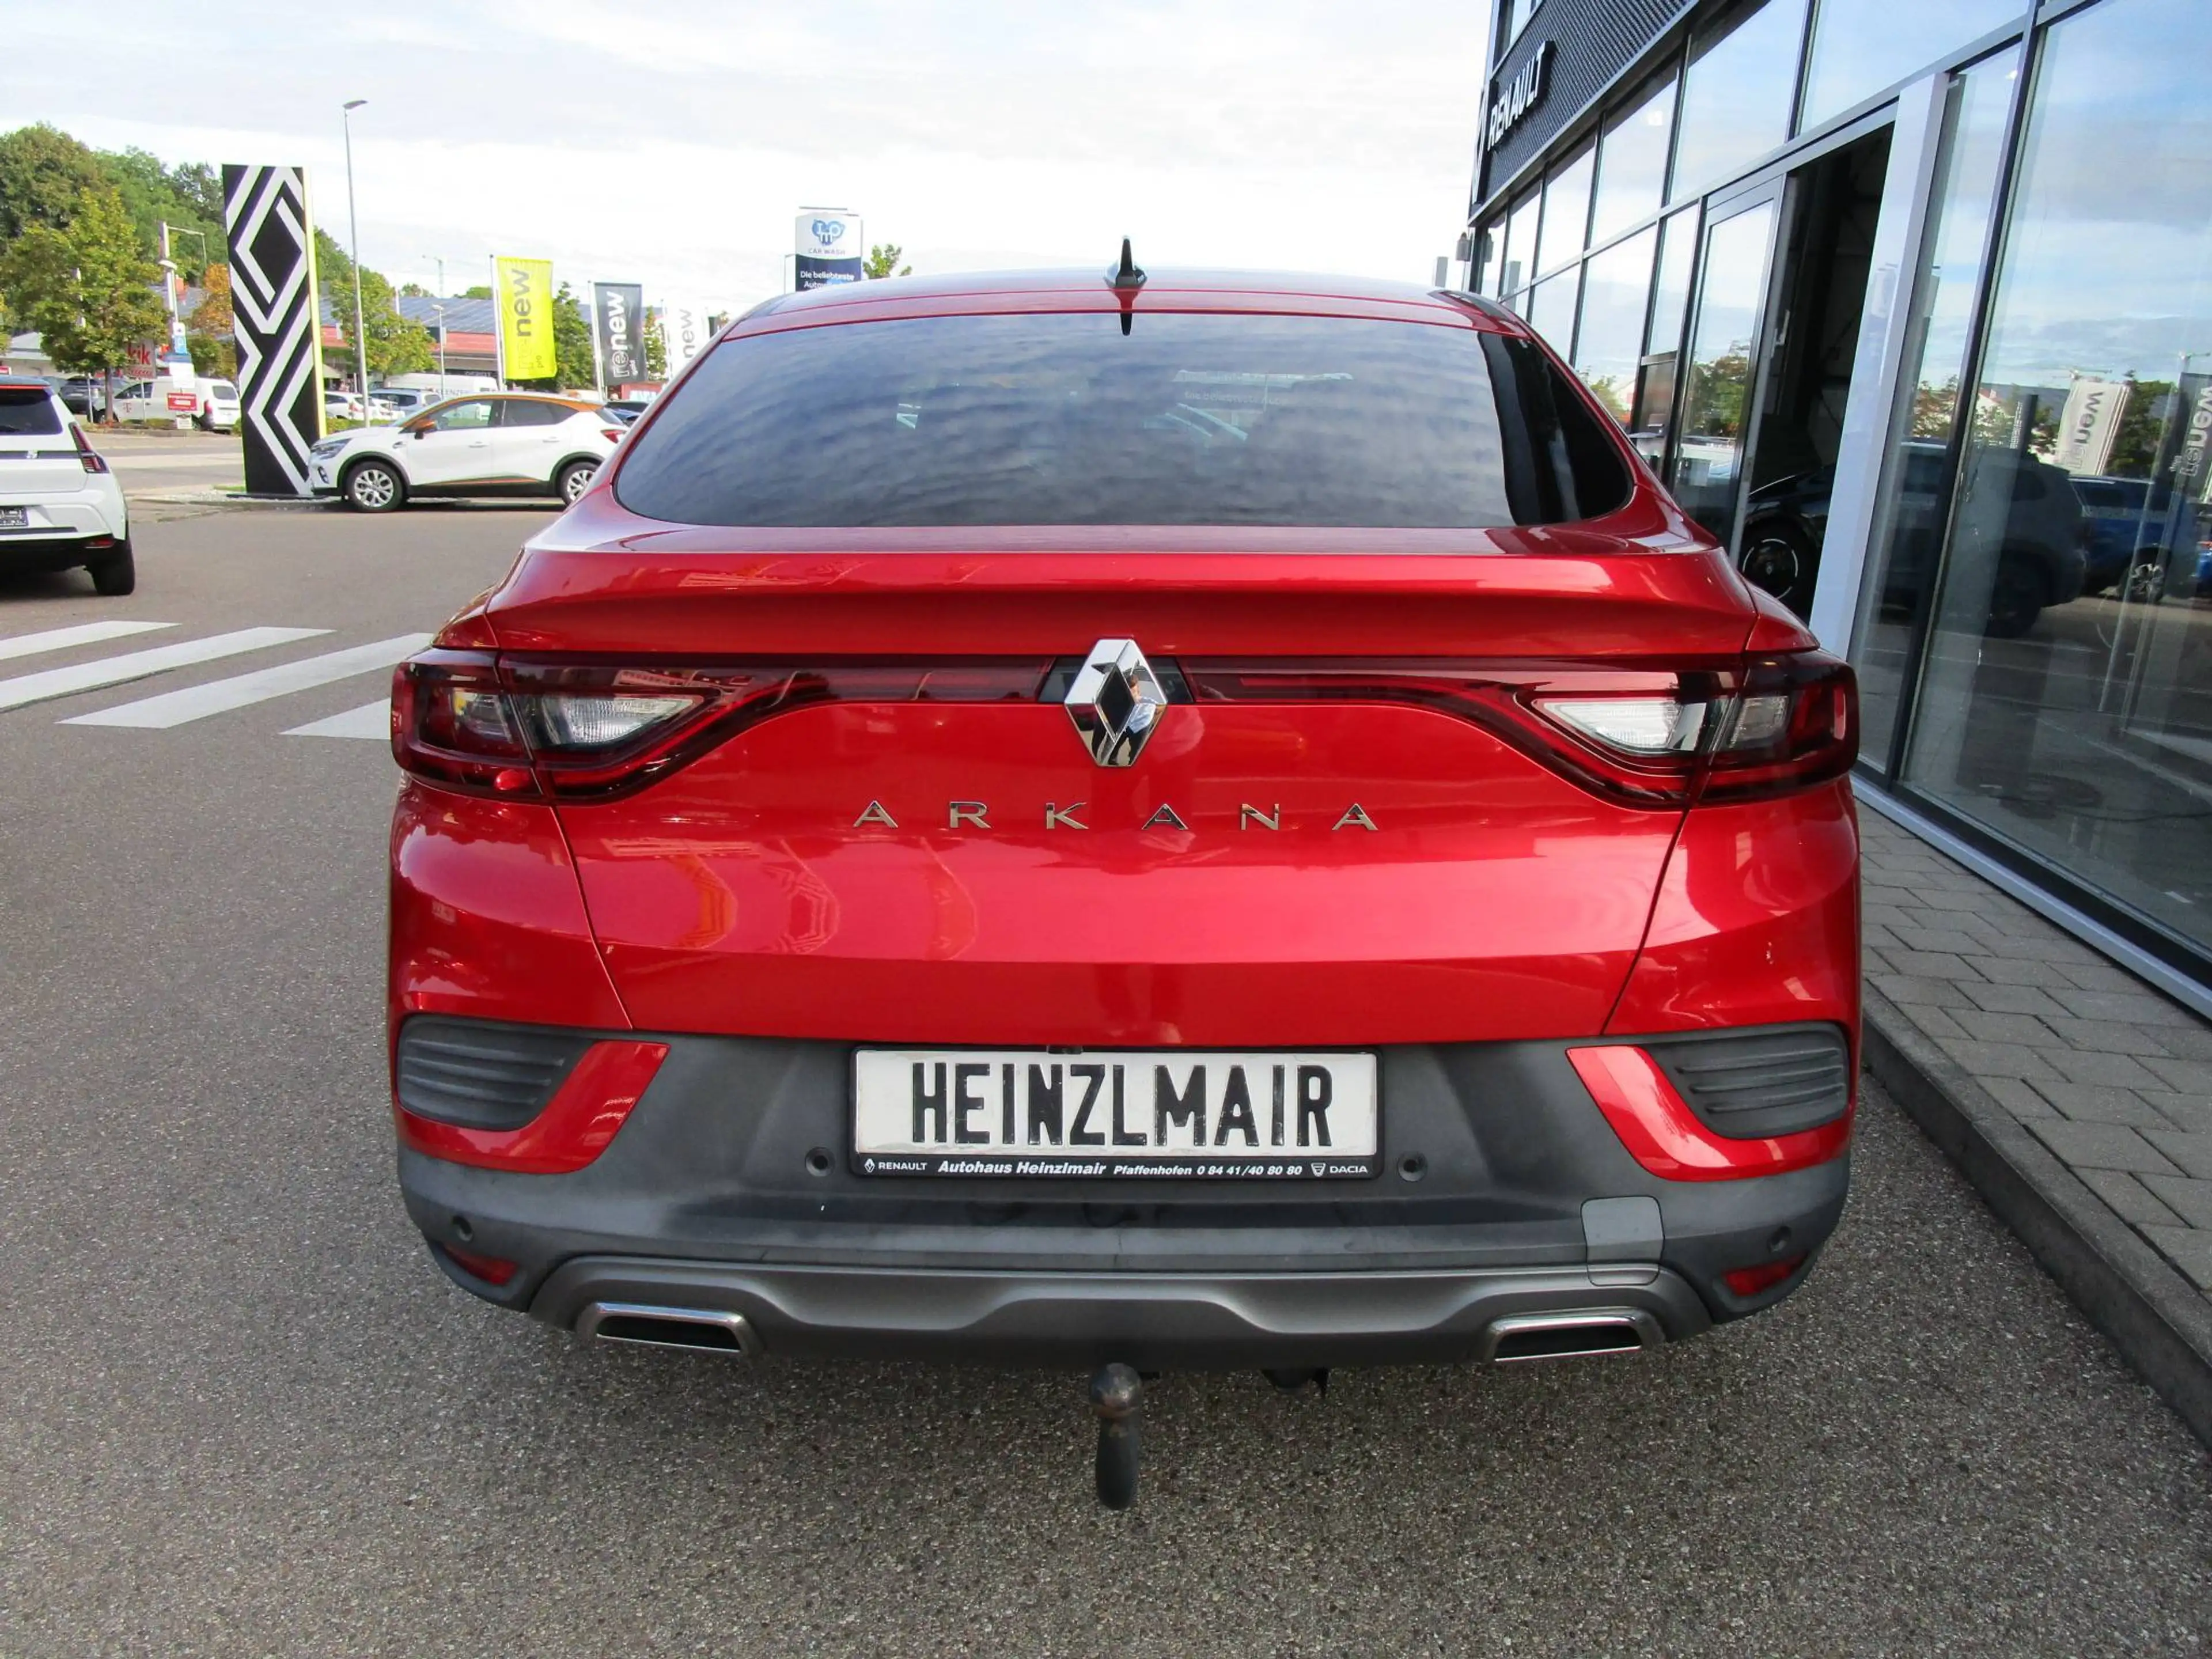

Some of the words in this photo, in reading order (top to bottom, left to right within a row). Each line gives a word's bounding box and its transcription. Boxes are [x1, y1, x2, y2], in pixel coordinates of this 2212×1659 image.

[1487, 41, 1546, 151] RENAULT
[800, 270, 812, 278] Die
[606, 291, 630, 378] renew
[853, 800, 1378, 831] ARKANA
[912, 1062, 1333, 1147] HEINZLMAIR
[878, 1162, 927, 1171] RENAULT
[938, 1160, 1013, 1174] Autohaus
[1016, 1161, 1106, 1175] Heinzlmair
[1113, 1165, 1192, 1176] Pfaffenhofen
[1196, 1165, 1205, 1175] 0
[1208, 1165, 1224, 1175] 84
[1226, 1165, 1263, 1176] 41/40
[1267, 1166, 1283, 1176] 80
[1286, 1166, 1302, 1176] 80
[1329, 1165, 1368, 1174] DACIA
